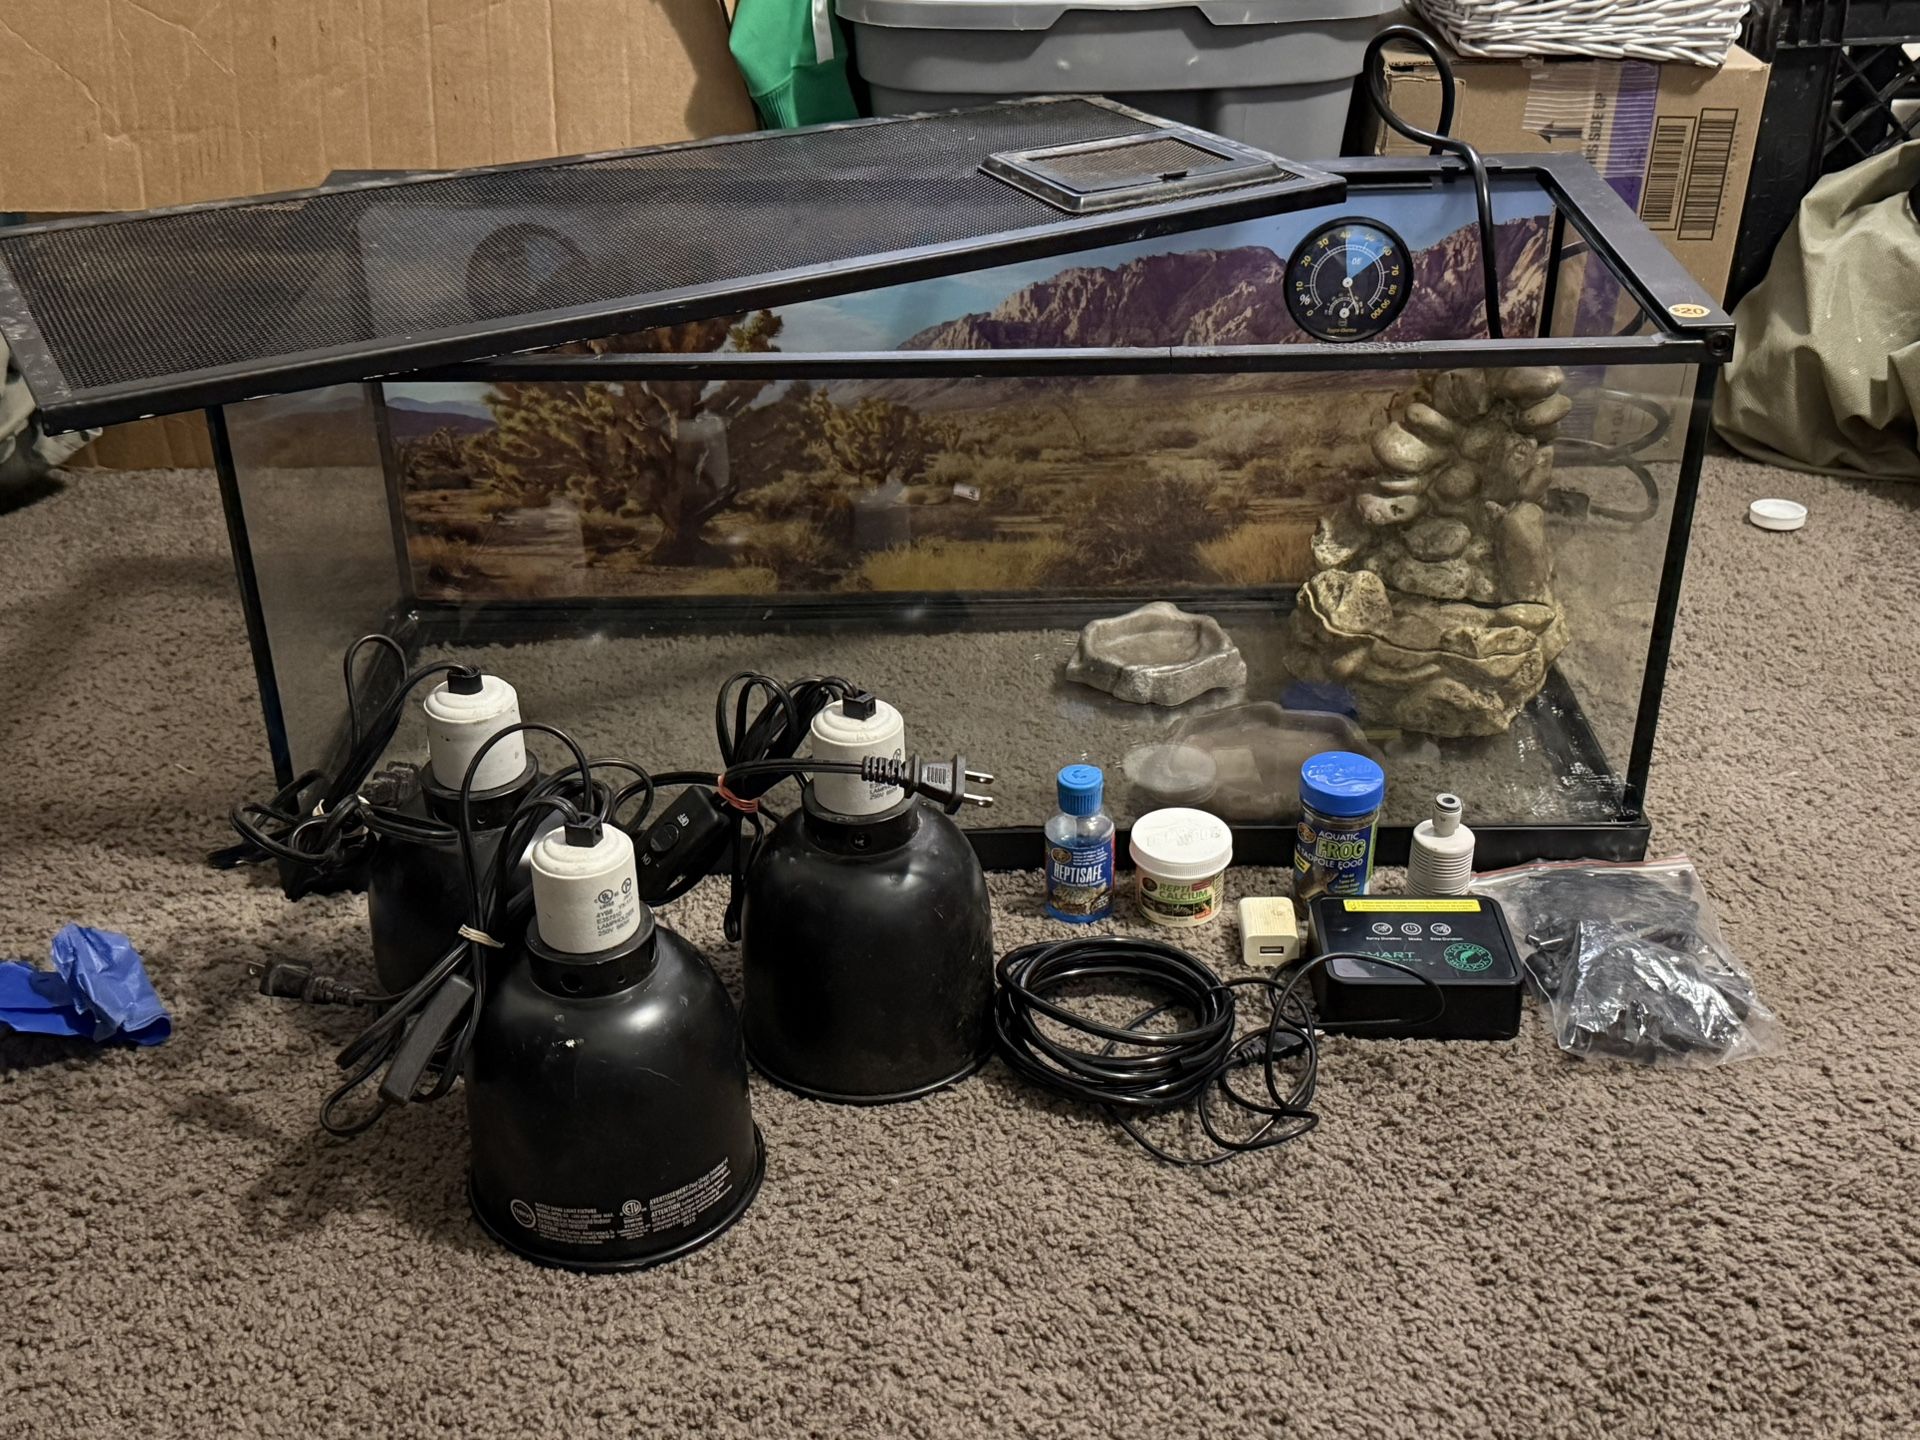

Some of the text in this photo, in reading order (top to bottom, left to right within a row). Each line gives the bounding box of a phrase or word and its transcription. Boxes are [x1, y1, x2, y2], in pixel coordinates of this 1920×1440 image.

[1593, 92, 1606, 110] UP
[1588, 111, 1604, 142] SIDE
[1318, 238, 1329, 248] 30
[1301, 255, 1311, 267] 20
[1391, 264, 1399, 276] 70
[1295, 281, 1304, 291] 10
[1388, 284, 1397, 295] 80
[1381, 299, 1391, 310] 90
[1318, 829, 1360, 841] AQUATIC
[1316, 837, 1366, 861] FROG
[1301, 847, 1335, 869] TADPOLE
[1337, 858, 1364, 869] FOOD
[1053, 862, 1103, 883] REPTISAFE
[1160, 883, 1190, 893] REPTI
[1159, 889, 1208, 900] CALCIUM
